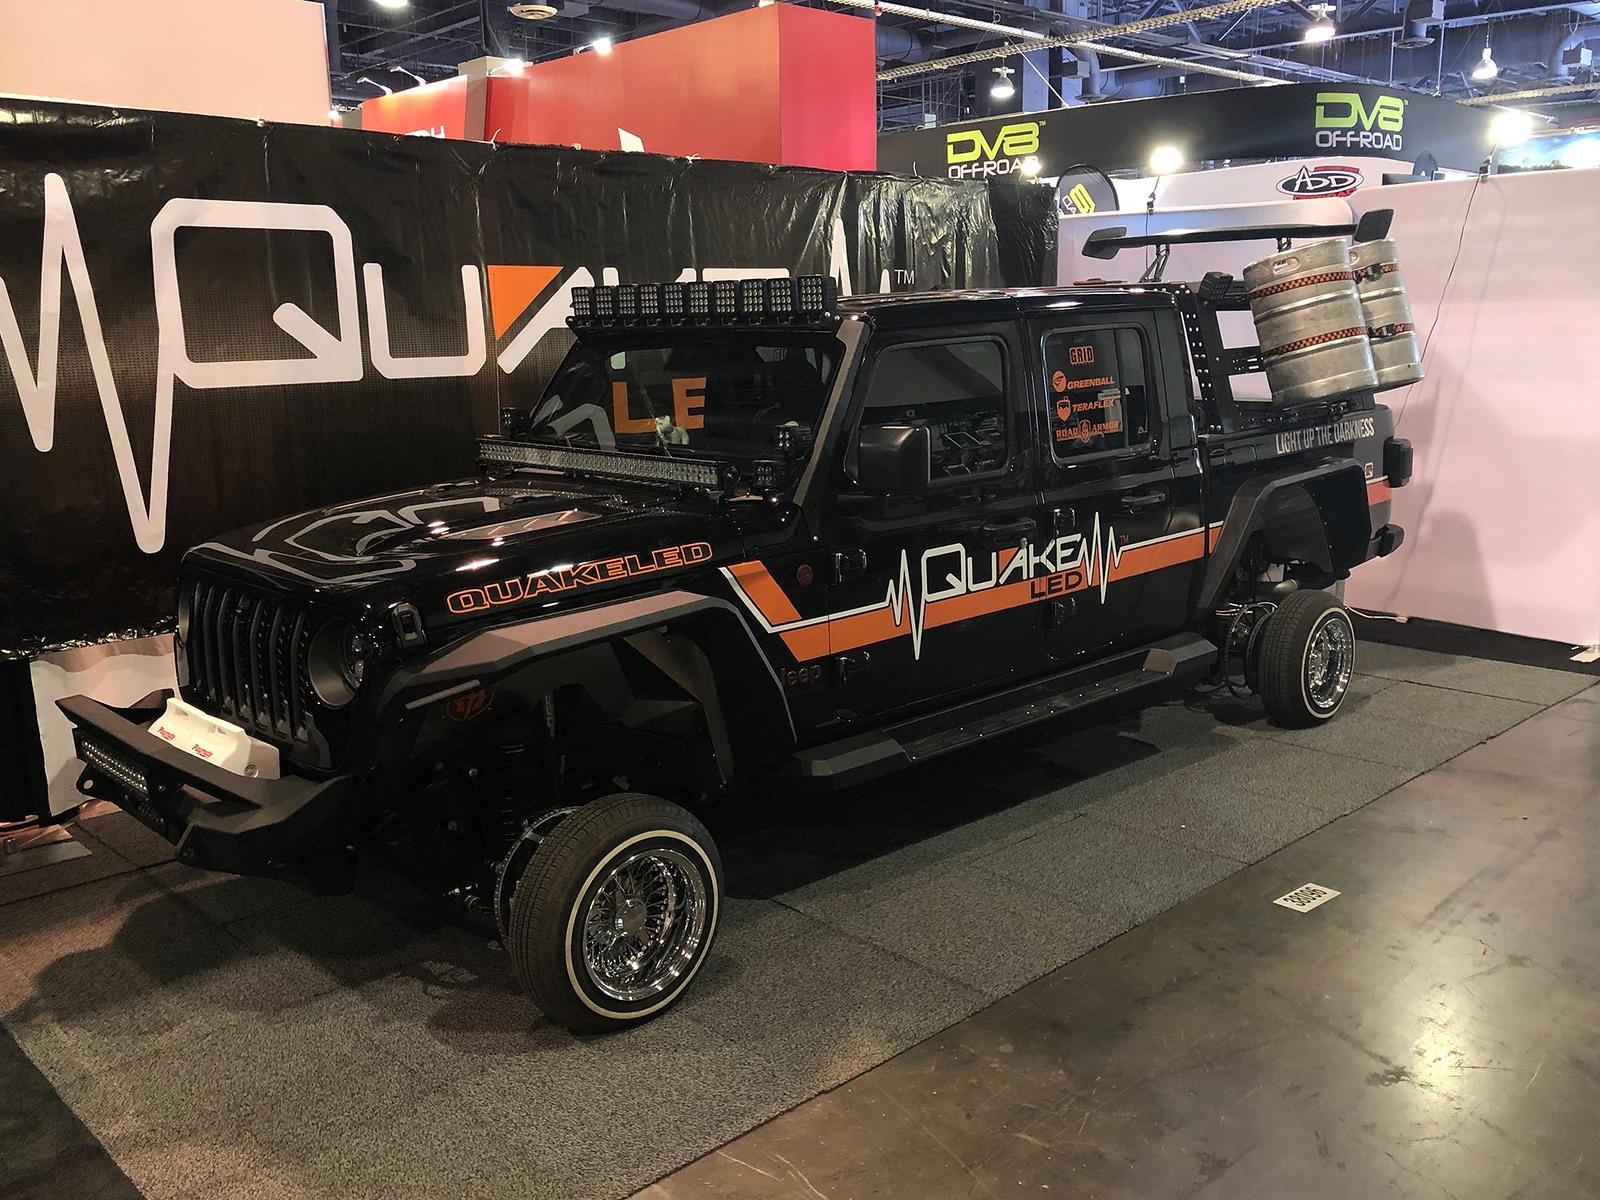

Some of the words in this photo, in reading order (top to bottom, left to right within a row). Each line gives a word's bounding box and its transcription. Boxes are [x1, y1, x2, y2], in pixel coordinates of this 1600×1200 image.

[1315, 92, 1404, 131] DV8
[947, 122, 1039, 164] DV8
[894, 269, 915, 285] TM
[1069, 346, 1094, 364] GRID
[1067, 376, 1115, 390] GREENBALL
[1072, 400, 1115, 412] TERAFLEX
[1056, 427, 1079, 438] ROAD
[1091, 421, 1120, 432] ARMOR
[1275, 431, 1302, 454] LIGHT
[1303, 427, 1315, 449] UP
[1316, 425, 1334, 446] THE
[1334, 417, 1375, 443] DARKNESS
[447, 542, 712, 613] QUAKELED
[921, 533, 1082, 603] QUAKE
[1030, 571, 1083, 600] LED
[1283, 886, 1327, 906] 38096
